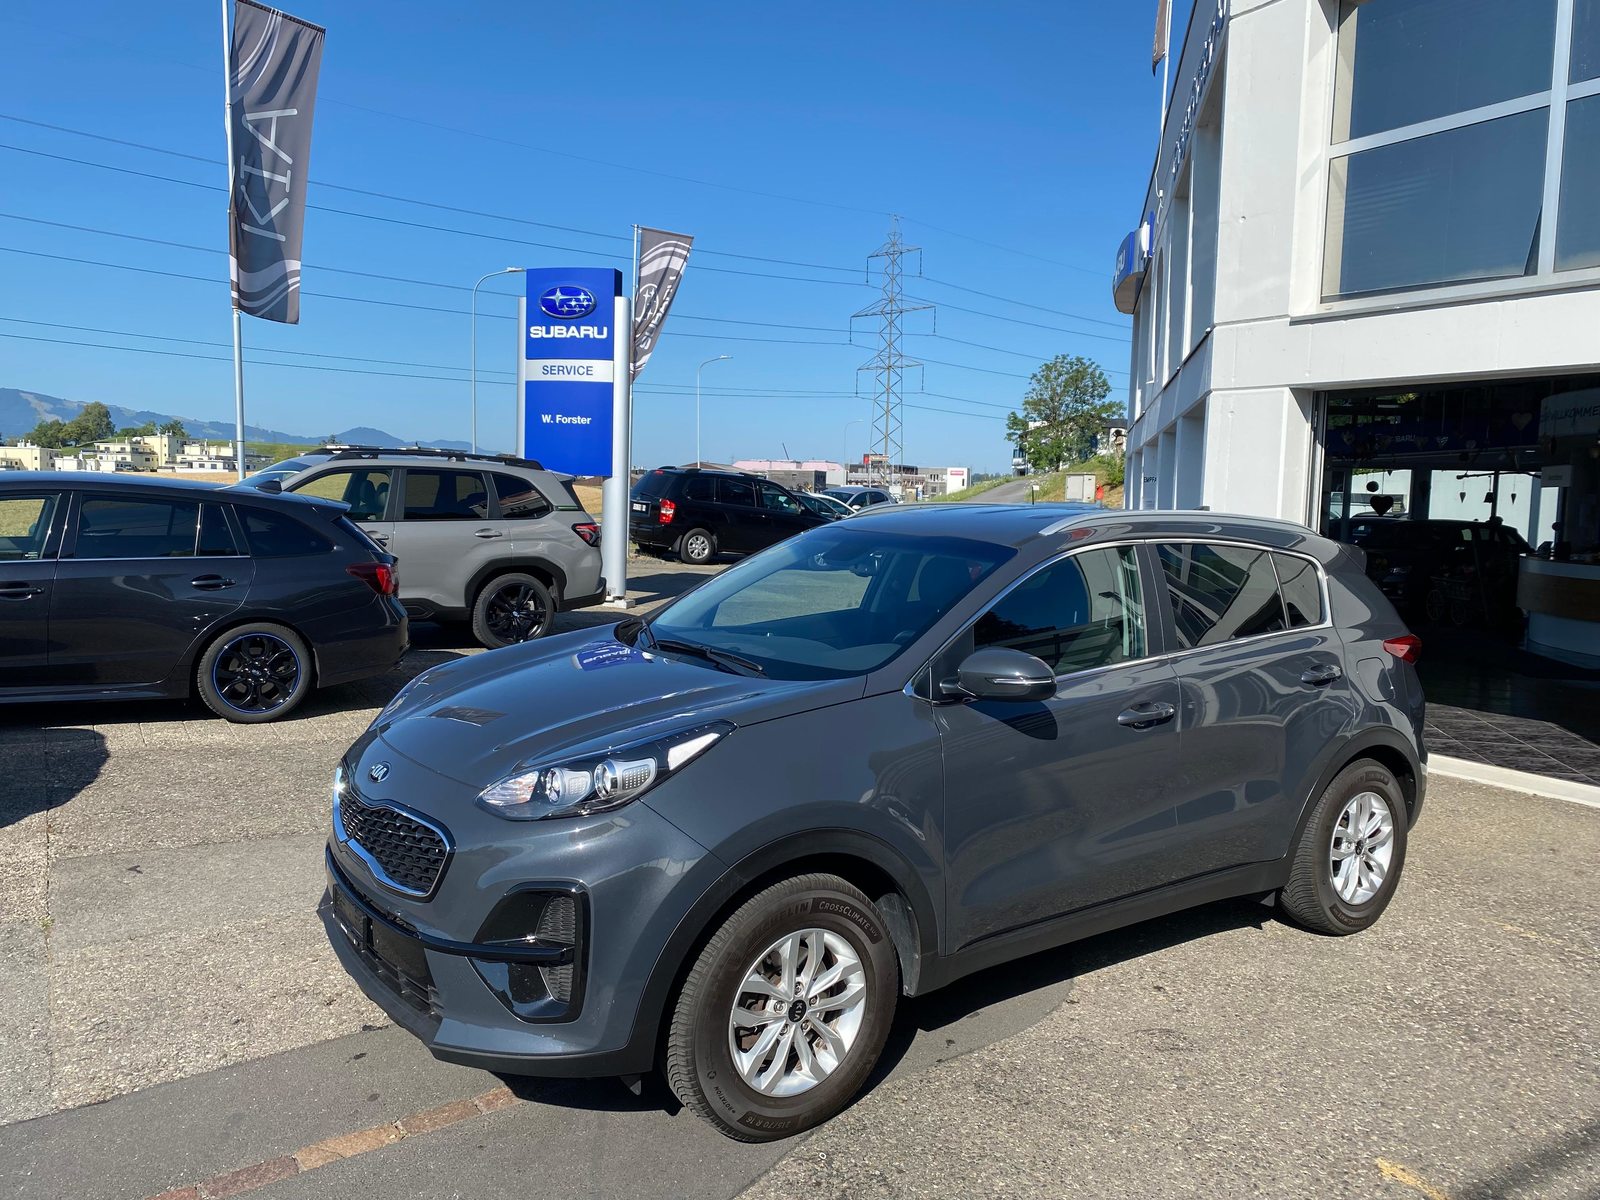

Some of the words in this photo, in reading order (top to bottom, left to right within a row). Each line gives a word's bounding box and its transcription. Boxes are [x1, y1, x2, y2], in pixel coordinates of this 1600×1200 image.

[240, 108, 298, 242] KIA
[529, 325, 608, 339] SUBARU
[541, 364, 594, 376] SERVICE
[541, 414, 554, 424] W.
[555, 414, 592, 425] Forster
[712, 1086, 730, 1112] ROTATION
